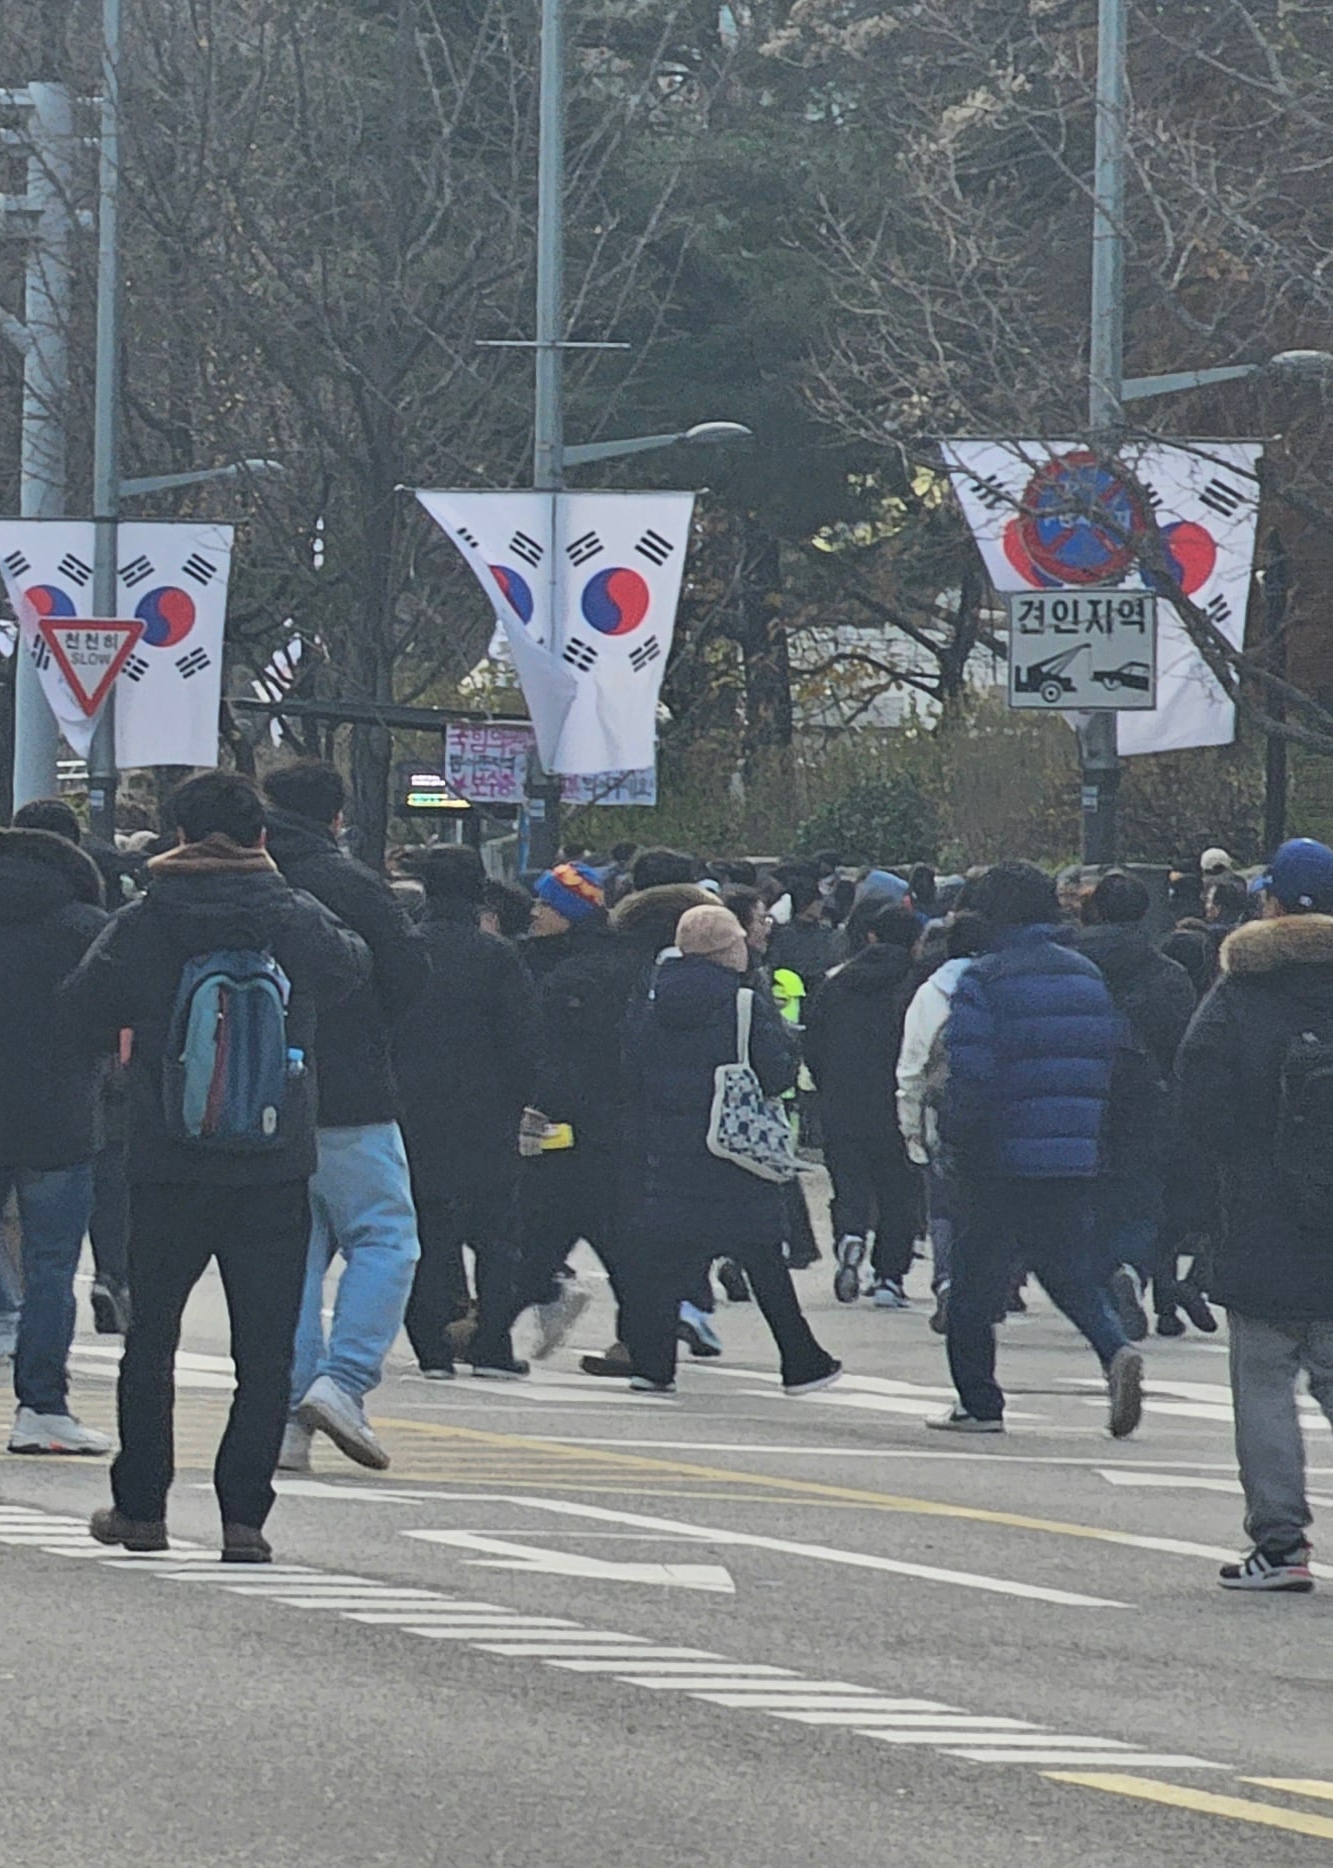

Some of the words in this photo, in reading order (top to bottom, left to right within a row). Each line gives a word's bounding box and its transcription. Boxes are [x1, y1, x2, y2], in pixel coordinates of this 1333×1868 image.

[1018, 599, 1145, 635] 견인지역
[65, 632, 118, 650] 천천히
[71, 652, 111, 665] SLOW
